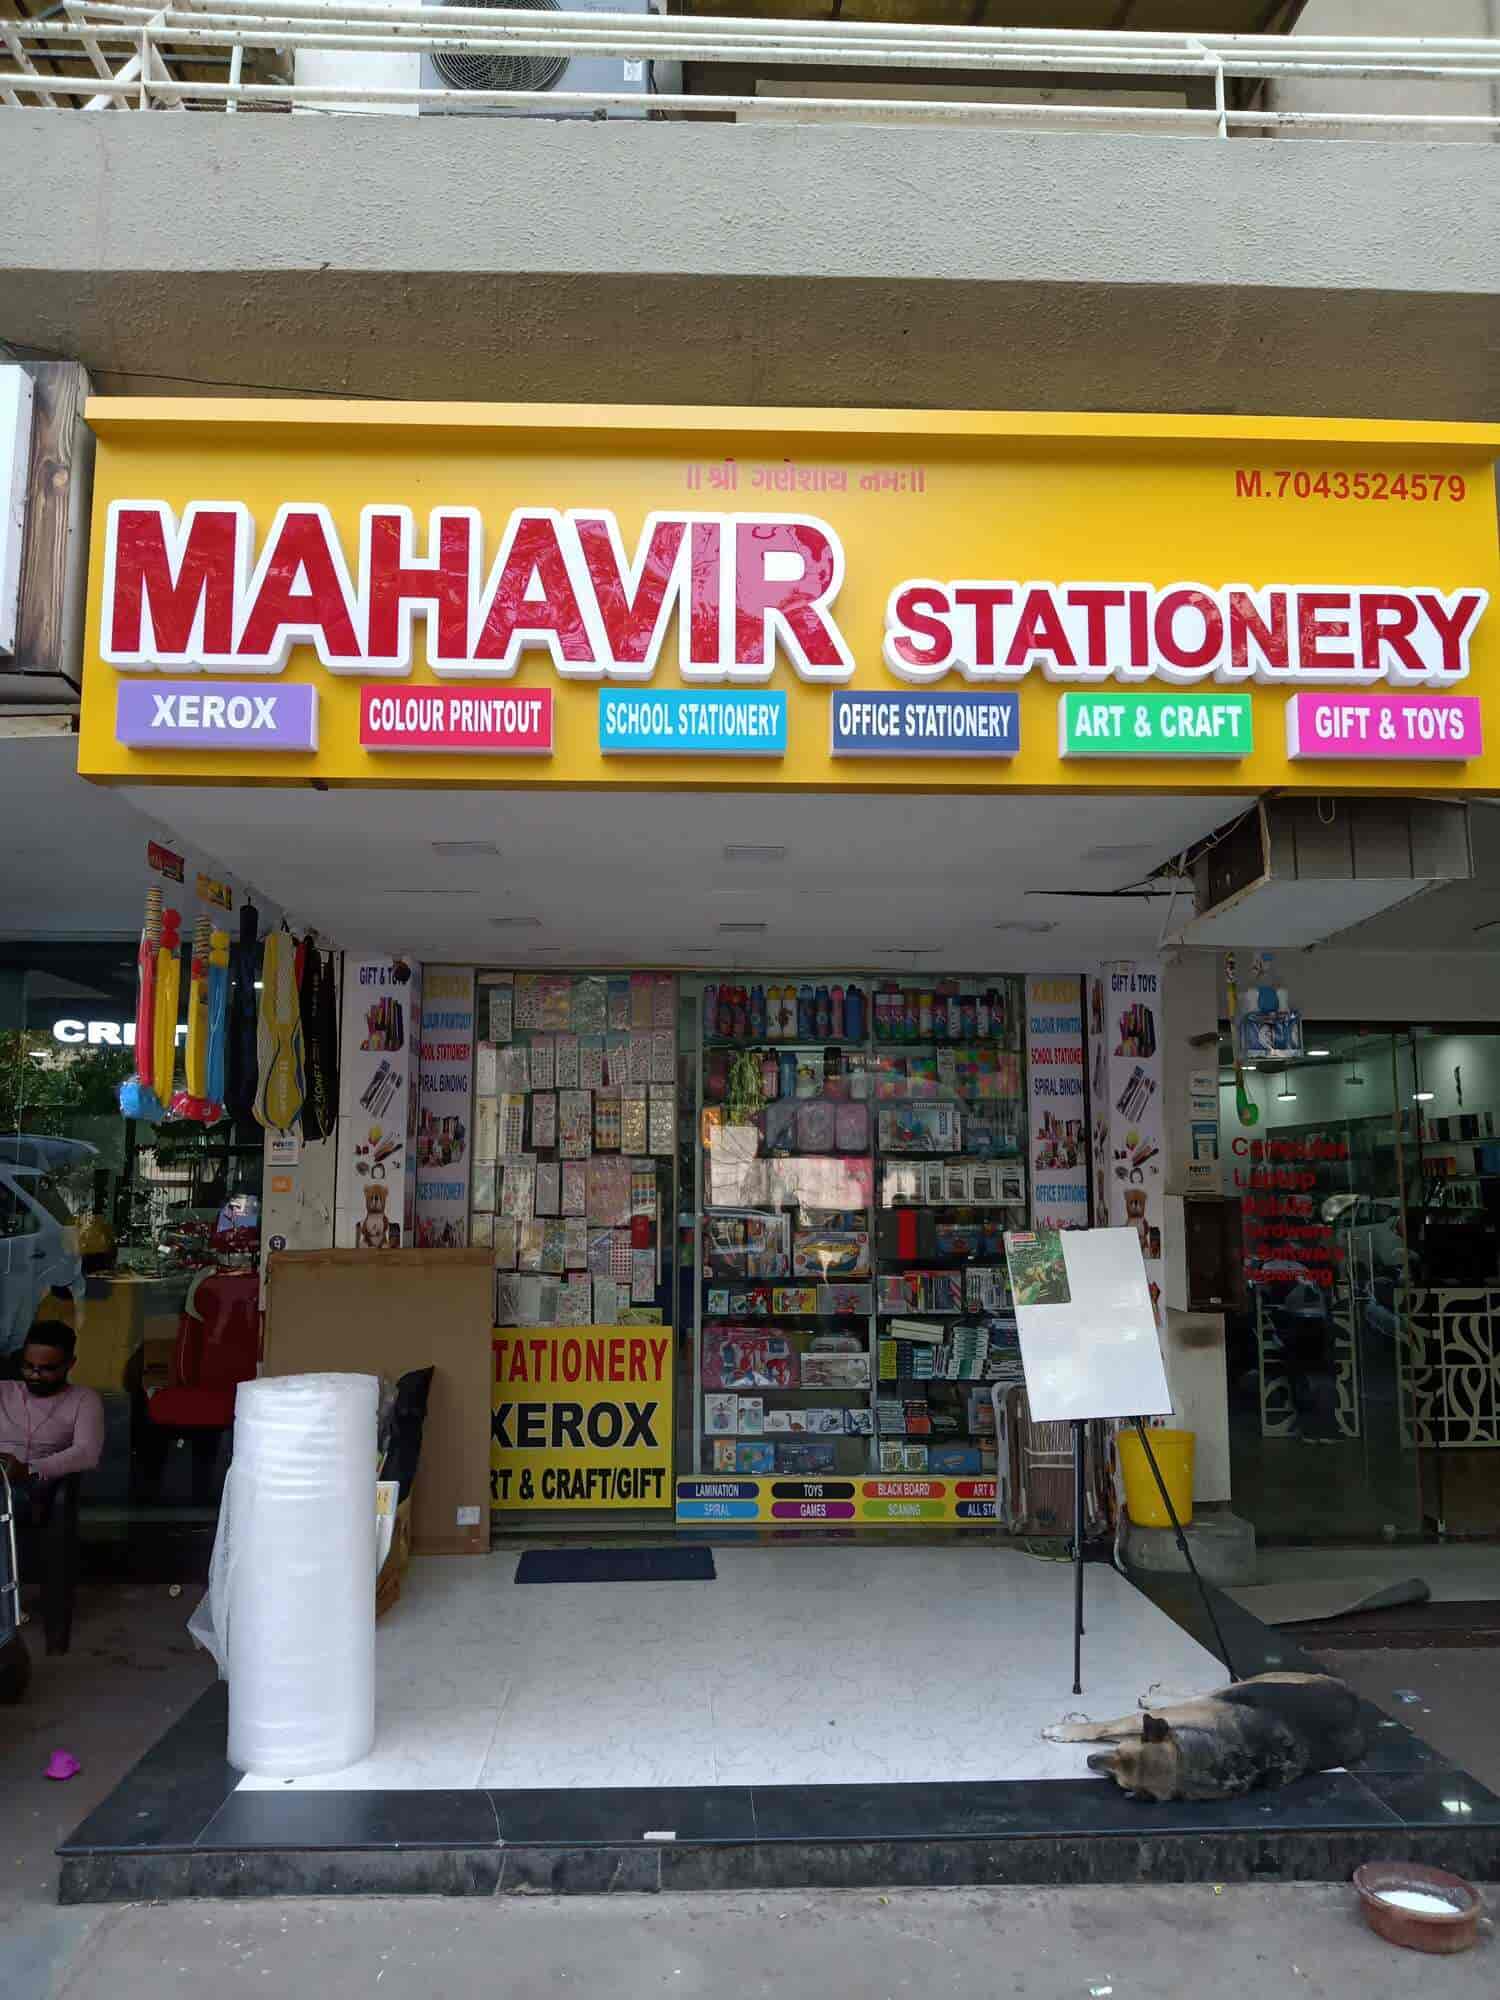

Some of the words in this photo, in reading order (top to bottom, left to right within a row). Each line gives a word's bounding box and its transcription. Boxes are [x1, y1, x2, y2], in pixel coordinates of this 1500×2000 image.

[1235, 470, 1467, 502] M.7043524579
[110, 507, 844, 669] MAHAVIR
[893, 585, 1481, 673] STATIONERY
[151, 694, 277, 730] XEROX
[369, 698, 444, 733] COLOUR
[449, 699, 542, 734] PRINTOUT
[606, 703, 673, 735] SCHOOL
[679, 703, 779, 737] STATIONERY
[839, 703, 900, 737] OFFICE
[904, 704, 1012, 738] STATIONERY
[1075, 705, 1125, 737] ART
[1134, 706, 1152, 737] &
[1159, 706, 1242, 737] CRAFT
[1314, 706, 1370, 739] GIFT
[1379, 708, 1397, 740] &
[1402, 708, 1465, 740] TOYS
[359, 967, 378, 984] GIFT
[1111, 975, 1130, 992] GIFT
[1140, 975, 1157, 993] TOYS
[491, 1337, 669, 1384] TATIONERY
[518, 1467, 535, 1500] &
[541, 1466, 667, 1501] CRAFT/GIFT
[695, 1483, 740, 1497] LAMINATION
[803, 1484, 824, 1497] TOYS
[877, 1483, 903, 1497] BLACK
[903, 1483, 930, 1497] BOARD
[973, 1483, 988, 1497] ART
[703, 1503, 730, 1516] SPIRAL
[800, 1503, 826, 1517] GAMES
[967, 1503, 980, 1517] ALL
